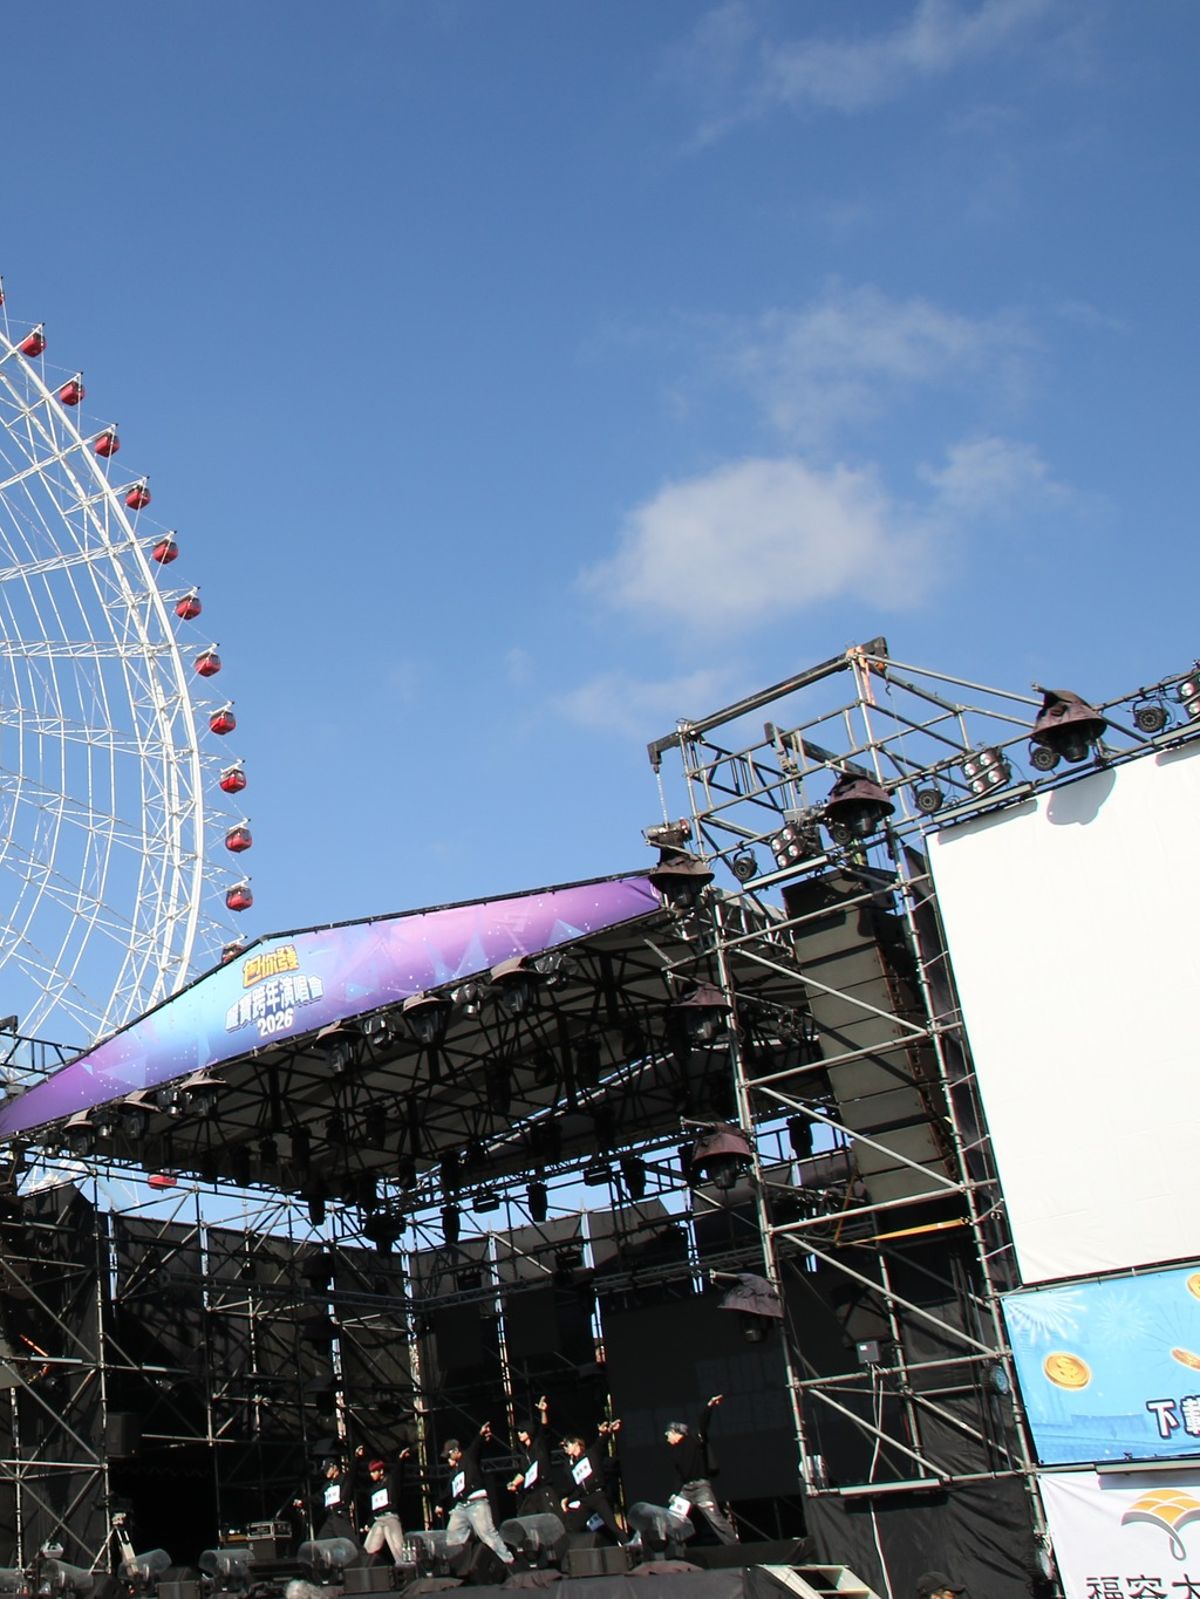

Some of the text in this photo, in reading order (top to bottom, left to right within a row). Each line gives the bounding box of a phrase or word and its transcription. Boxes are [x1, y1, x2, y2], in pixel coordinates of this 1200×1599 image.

[243, 945, 299, 988] 包你發
[257, 1008, 294, 1037] 2026
